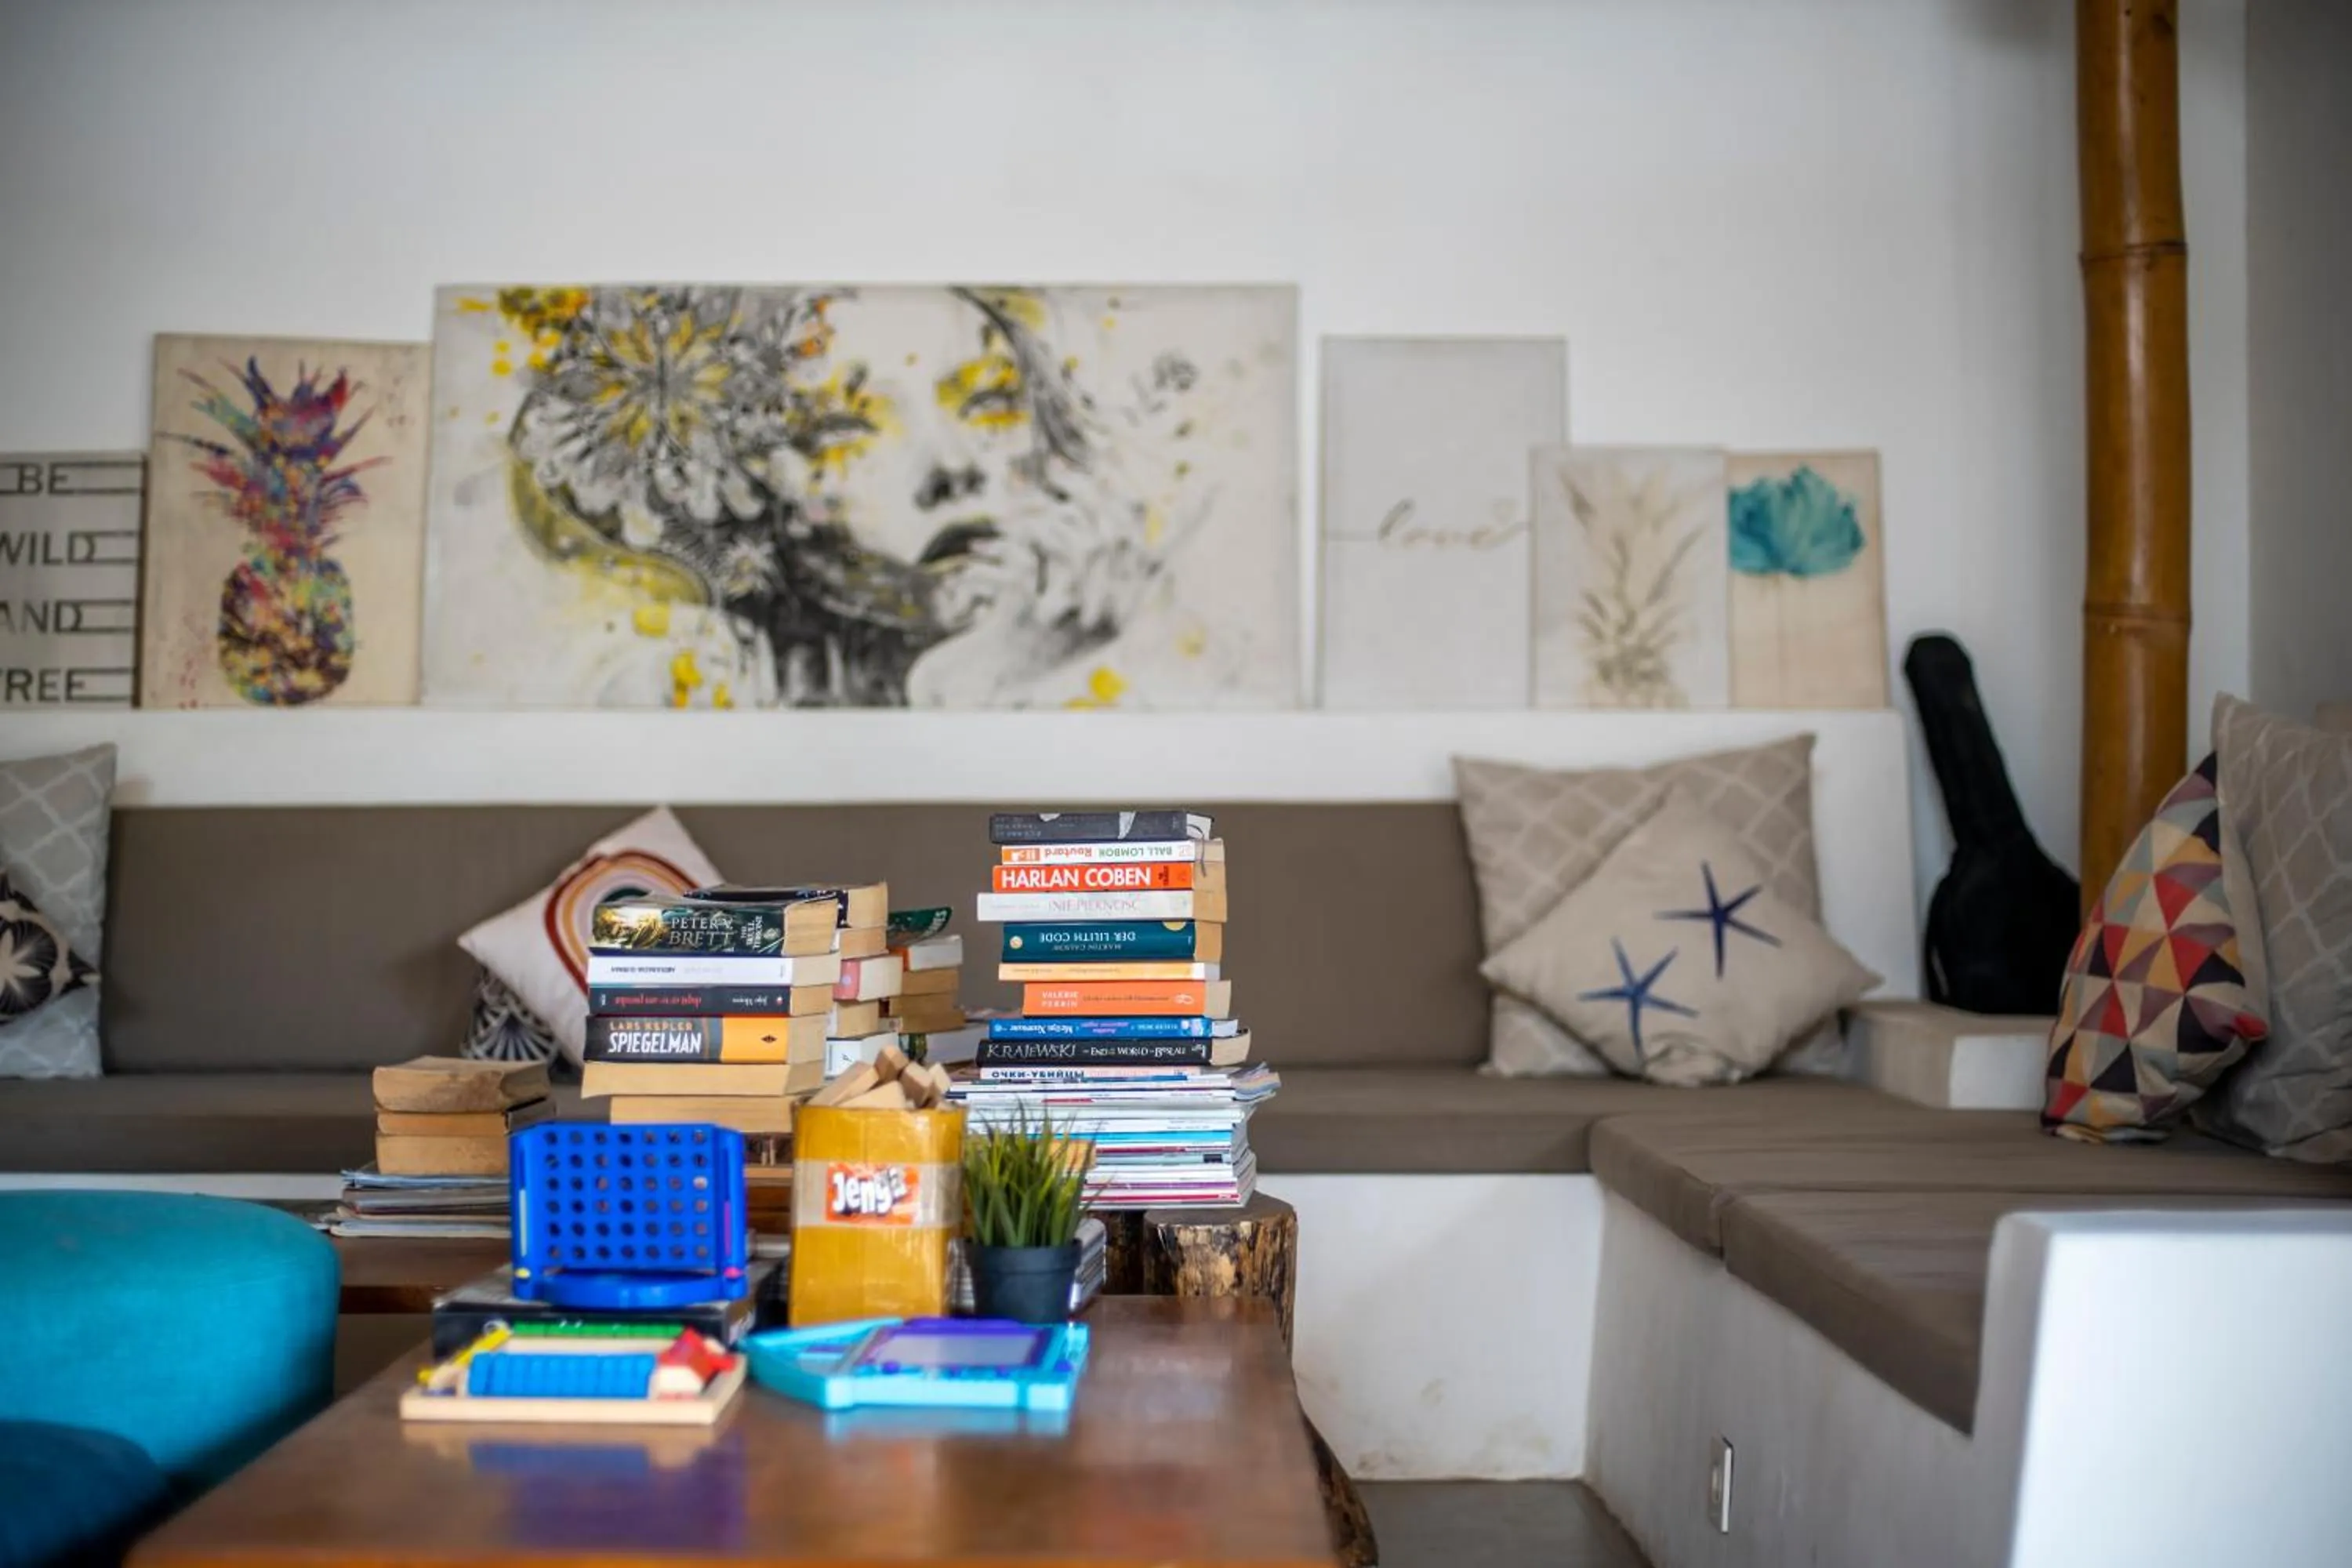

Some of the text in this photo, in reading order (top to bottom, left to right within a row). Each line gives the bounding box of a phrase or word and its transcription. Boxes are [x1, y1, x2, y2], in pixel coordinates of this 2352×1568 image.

[16, 463, 72, 494] BE
[0, 668, 85, 702] REE
[1045, 847, 1092, 858] Routard
[1098, 847, 1145, 857] LOMBOK
[1002, 869, 1079, 889] HARLAN
[1084, 867, 1151, 887] COBEN
[671, 917, 718, 929] PETER
[669, 931, 735, 947] BRETT
[1040, 931, 1135, 942] DER LILITH CODE
[610, 1022, 693, 1030] LARS KEPLER
[608, 1032, 702, 1053] SPIEGELMAN
[987, 1043, 1076, 1058] KRAJEWSKI
[992, 1070, 1084, 1080] ОЧКИ-УБИЙЦЫ
[832, 1167, 907, 1214] Jenga
